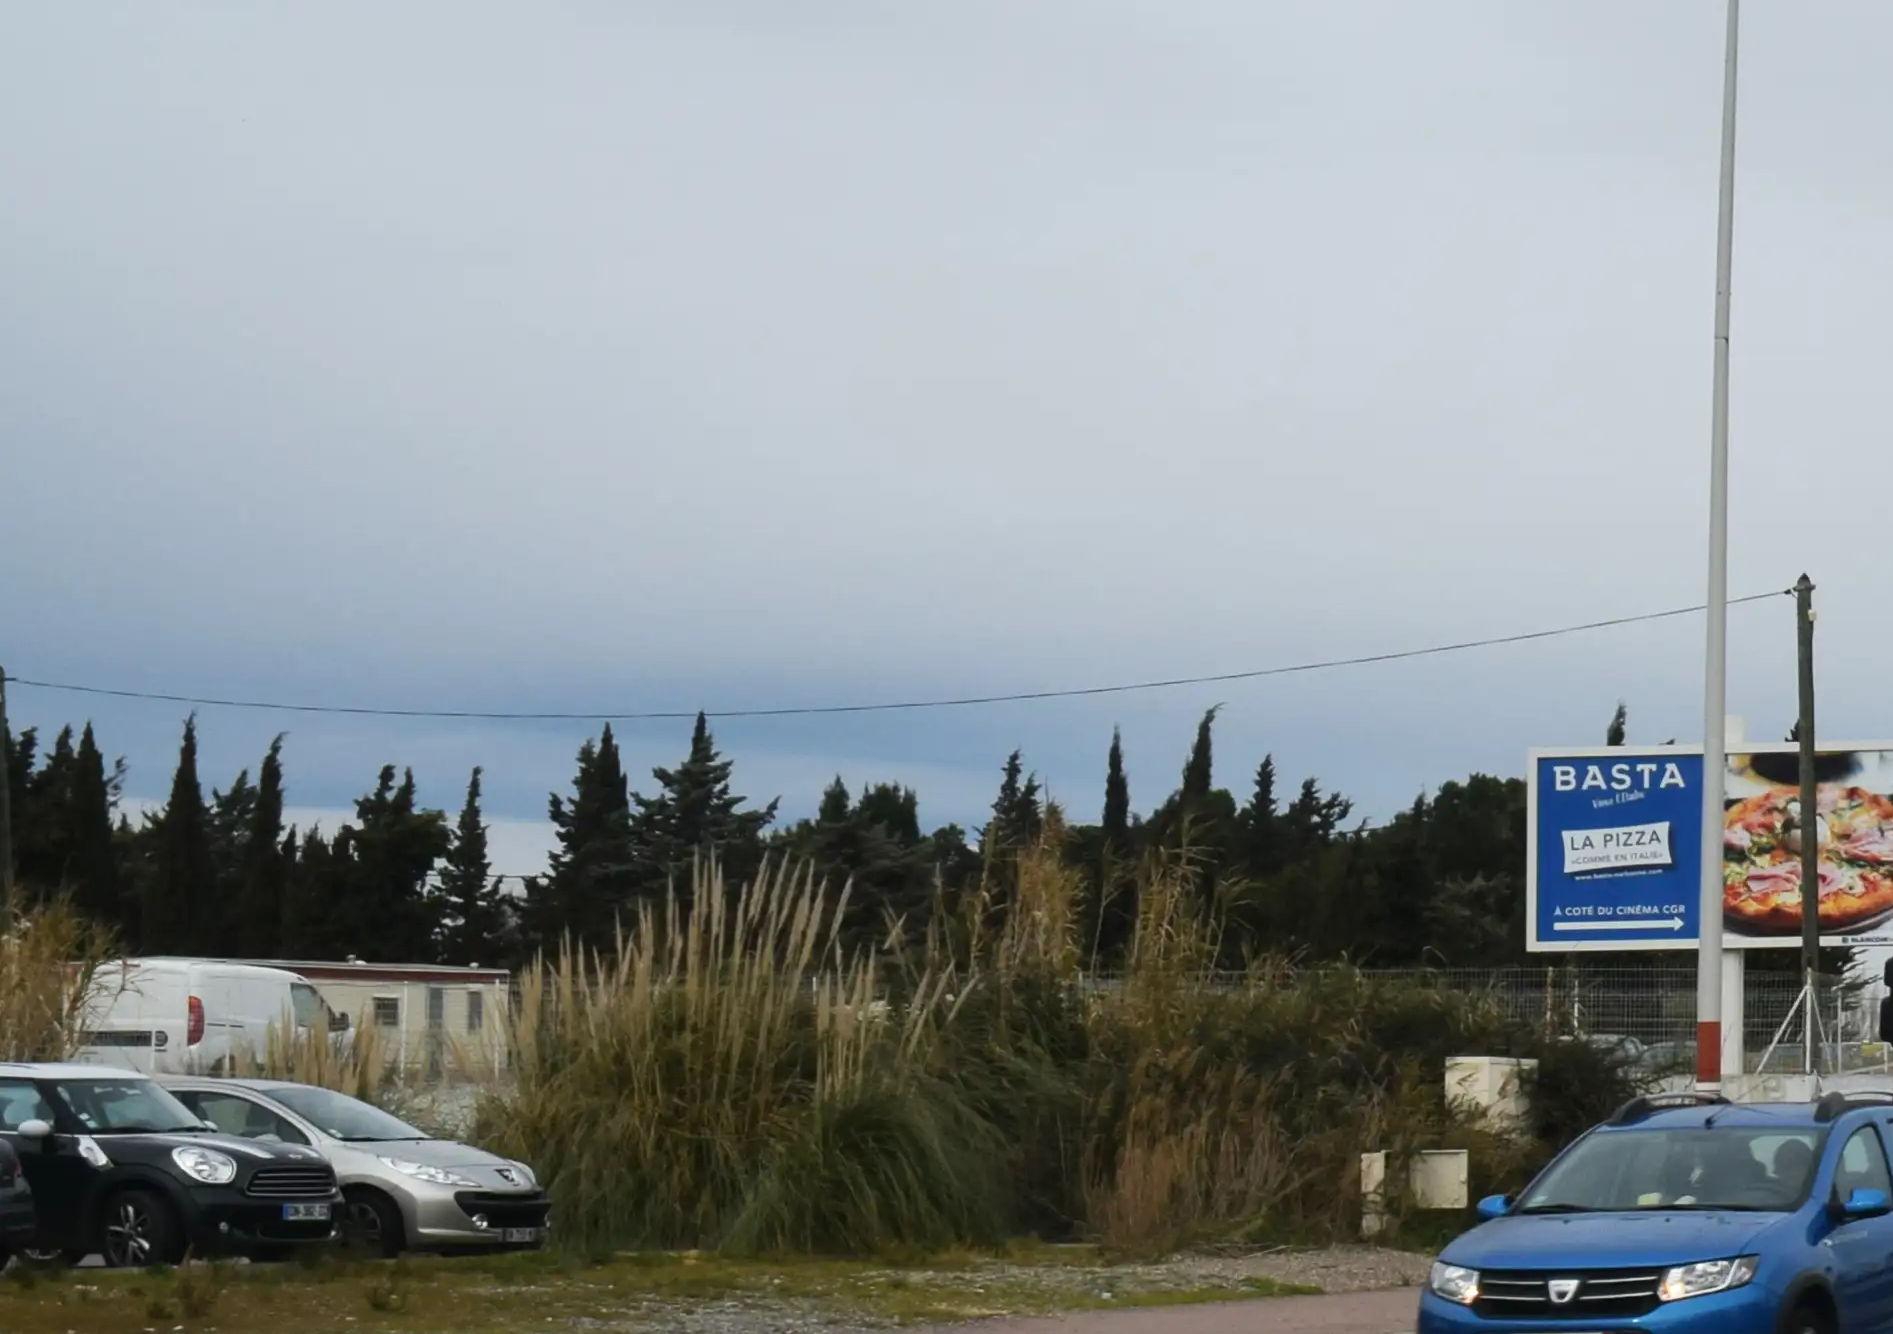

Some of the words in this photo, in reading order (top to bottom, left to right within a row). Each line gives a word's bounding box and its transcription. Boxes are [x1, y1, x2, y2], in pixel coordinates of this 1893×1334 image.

[1553, 763, 1686, 791] BASTA
[1570, 835, 1595, 851] LA
[1603, 829, 1662, 848] PIZZA
[1597, 906, 1614, 915] DU
[1662, 904, 1686, 914] CGR
